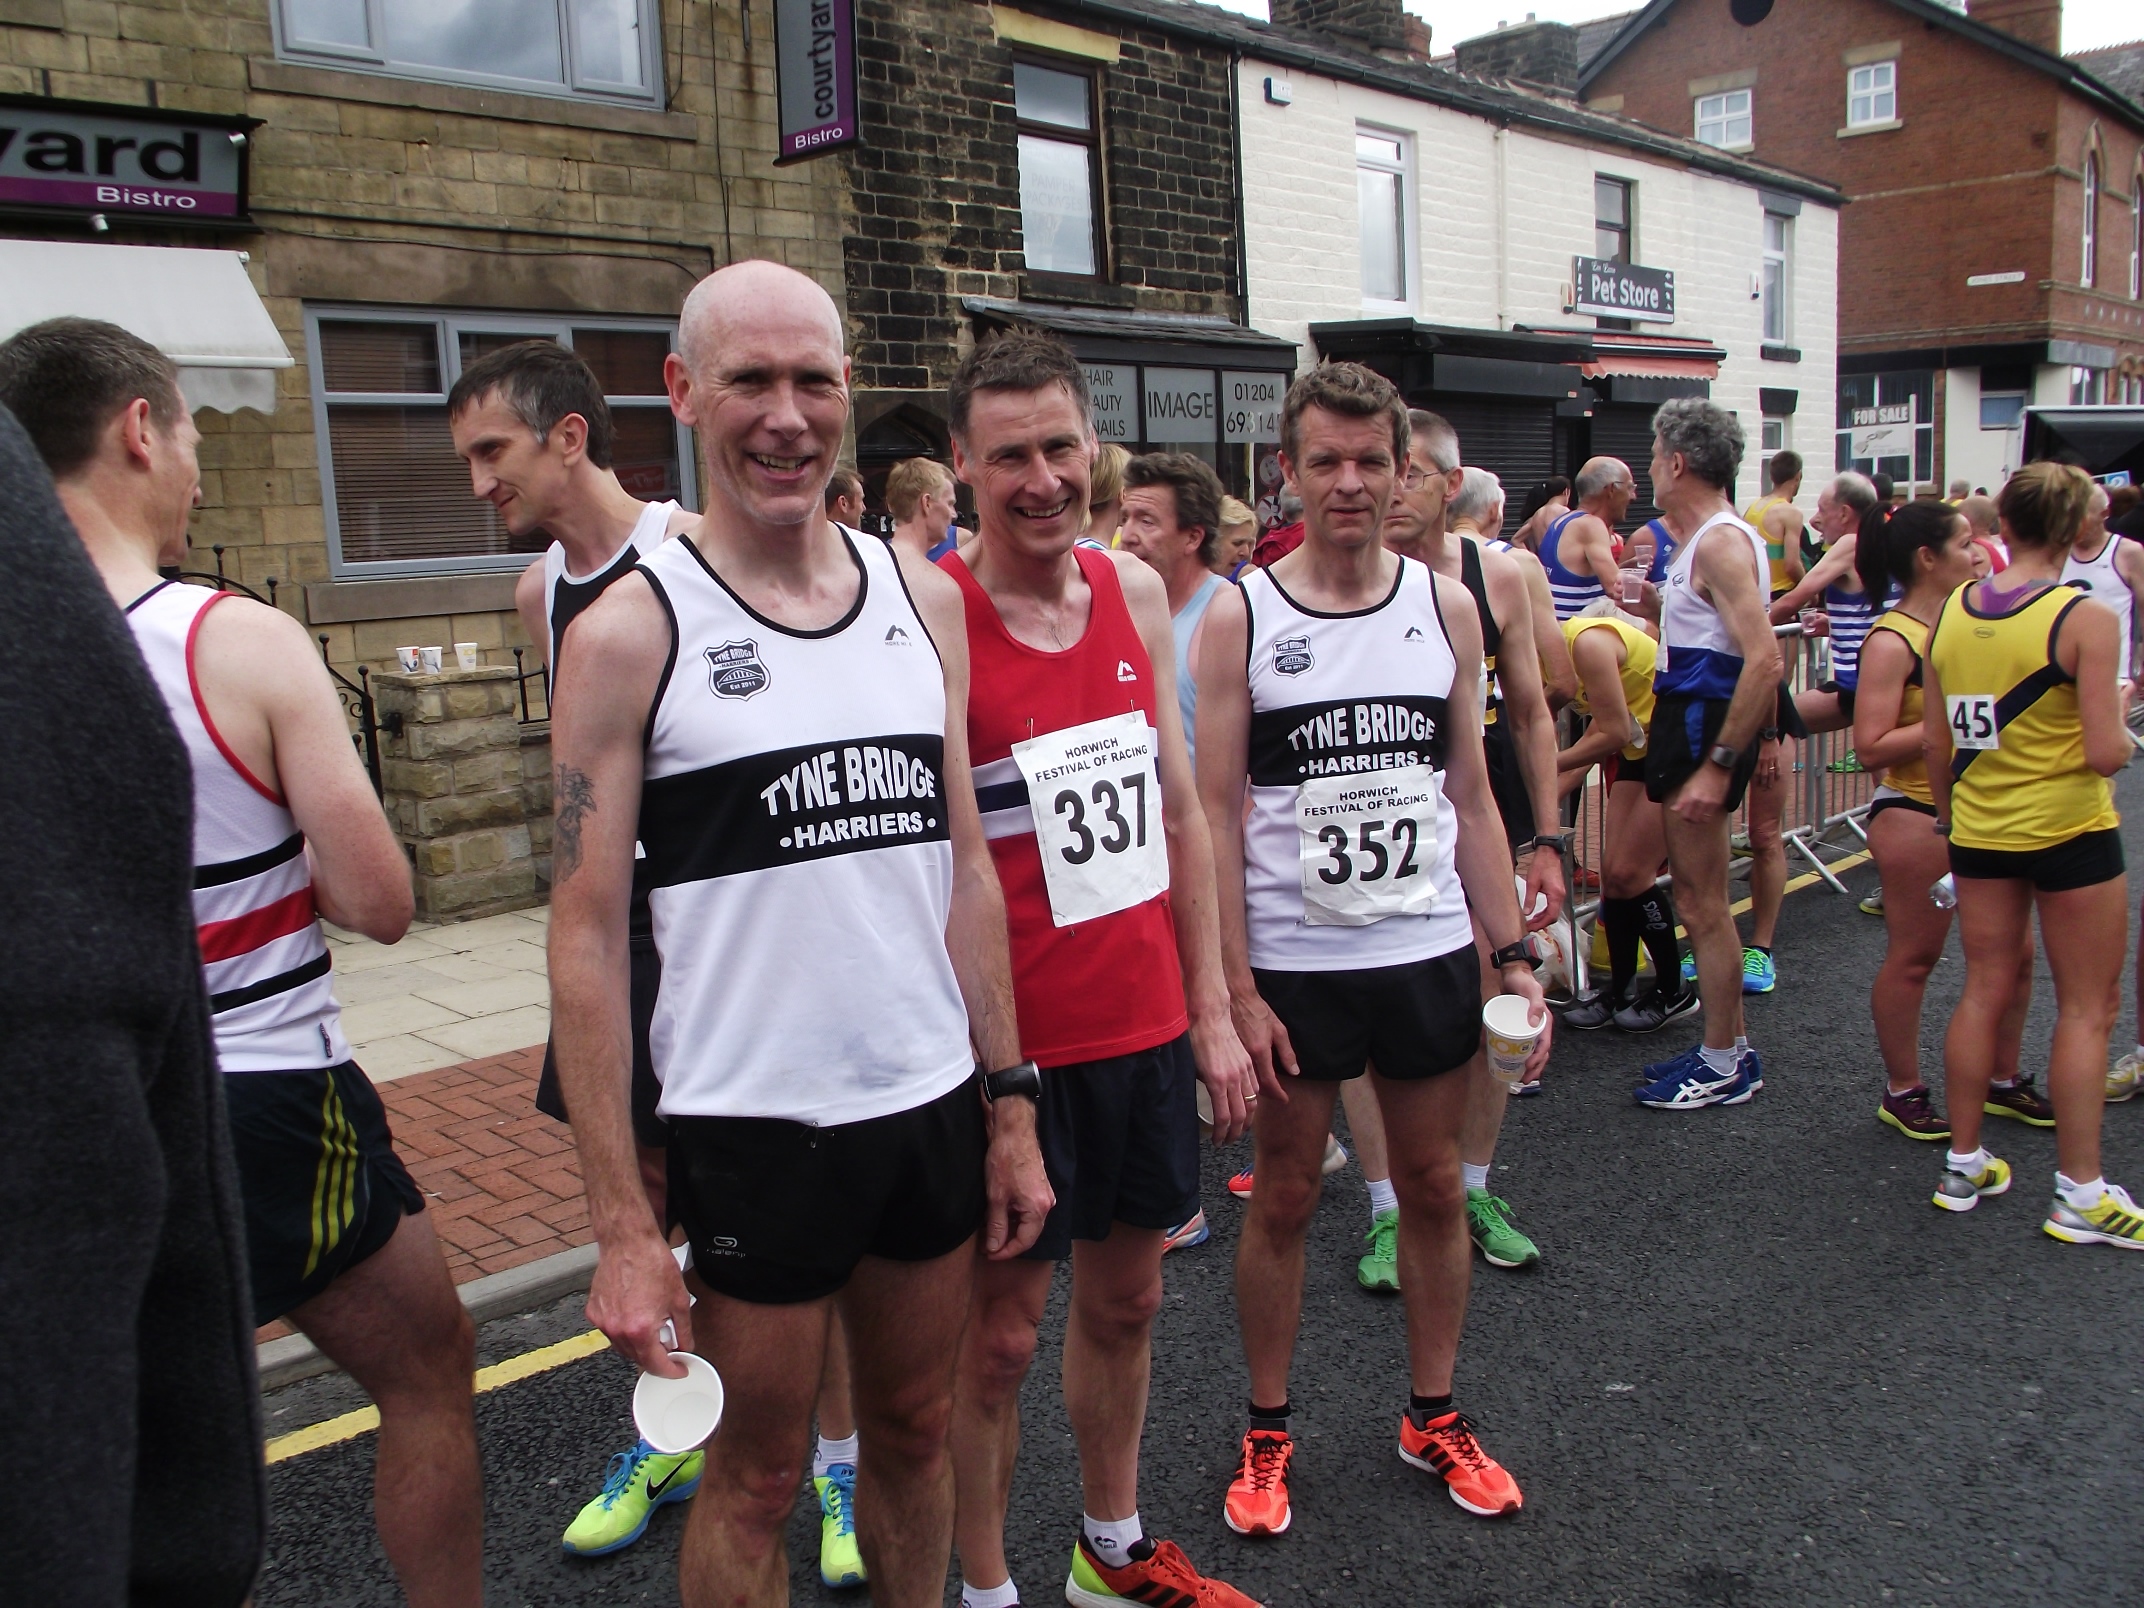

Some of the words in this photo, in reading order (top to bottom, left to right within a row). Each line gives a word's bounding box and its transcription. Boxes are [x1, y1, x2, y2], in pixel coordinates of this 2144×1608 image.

[795, 127, 843, 149] Bistro
[0, 127, 199, 183] ard
[1031, 172, 1076, 193] PAMPER
[96, 186, 197, 209] Bistro
[1026, 190, 1083, 211] PACKAGES
[1591, 273, 1617, 304] Pet
[1620, 277, 1659, 309] Store
[1148, 391, 1214, 419] IMAGE
[1234, 383, 1275, 402] 01204
[1854, 409, 1877, 425] FOR
[1879, 406, 1908, 423] SALE
[1287, 707, 1349, 751] TYNE
[1354, 703, 1436, 745] BRIDGE
[1952, 701, 1993, 739] 45
[1064, 737, 1119, 760] HORWICH
[1035, 760, 1091, 783] FESTIVAL
[1093, 755, 1108, 767] OF
[1110, 744, 1148, 763] RACING
[760, 750, 841, 816] TYNE
[843, 746, 936, 803] BRIDGE
[1339, 785, 1399, 802] HORWICH
[1054, 771, 1146, 865] 337
[1304, 802, 1364, 817] FESTIVAL
[1367, 800, 1384, 810] OF
[1387, 793, 1429, 808] RACING
[1317, 817, 1420, 885] 352
